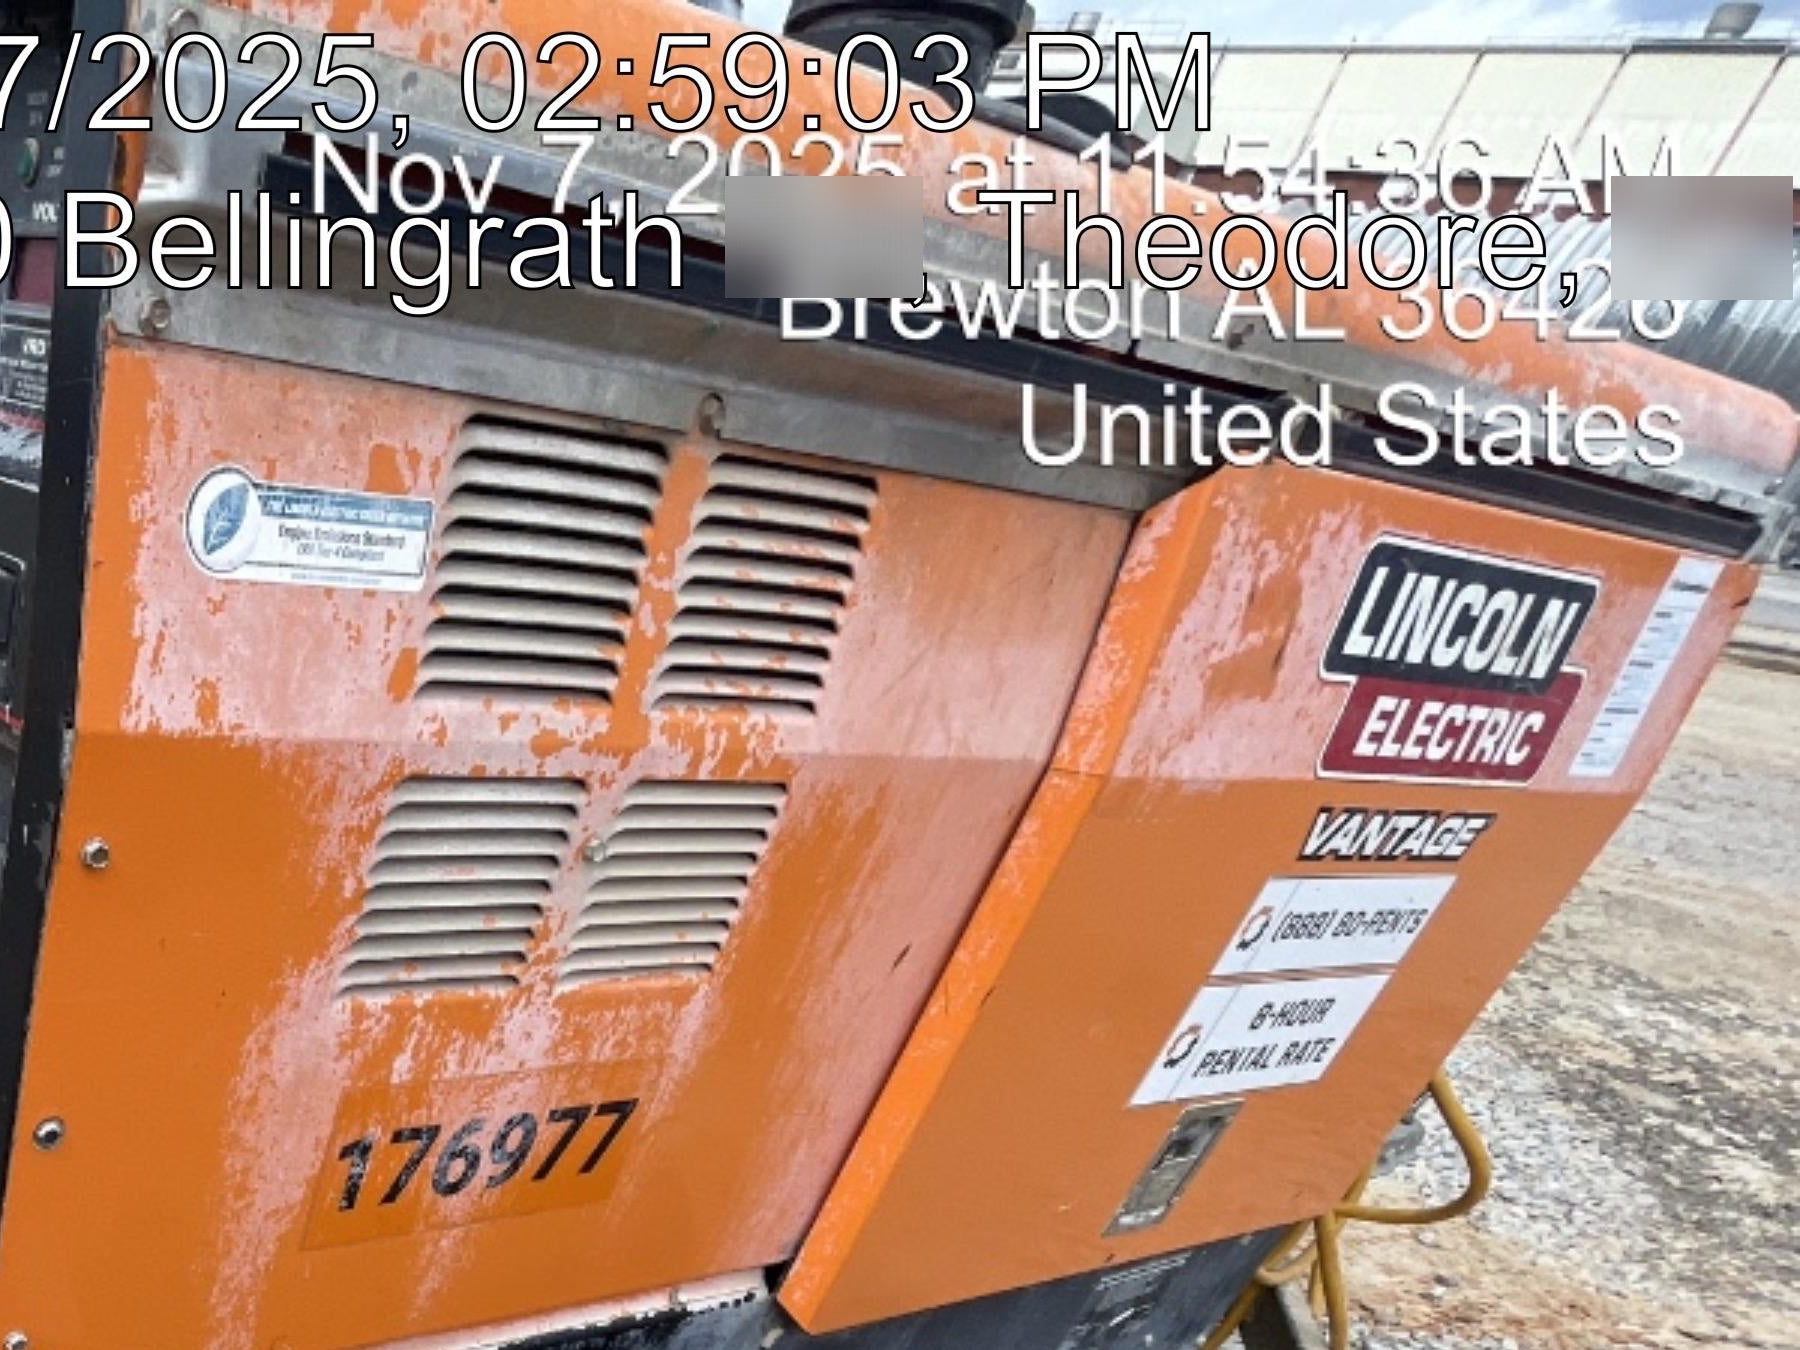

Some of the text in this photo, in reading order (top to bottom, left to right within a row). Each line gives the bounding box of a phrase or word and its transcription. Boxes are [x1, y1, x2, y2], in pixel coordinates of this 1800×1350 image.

[1342, 566, 1581, 680] LINCOLN
[1353, 696, 1546, 767] ELECTRIC
[1299, 809, 1492, 859] VANTAGE
[1248, 998, 1336, 1030] 8-HOUR
[1275, 1037, 1336, 1068] RATE
[337, 1097, 639, 1212] 176977
